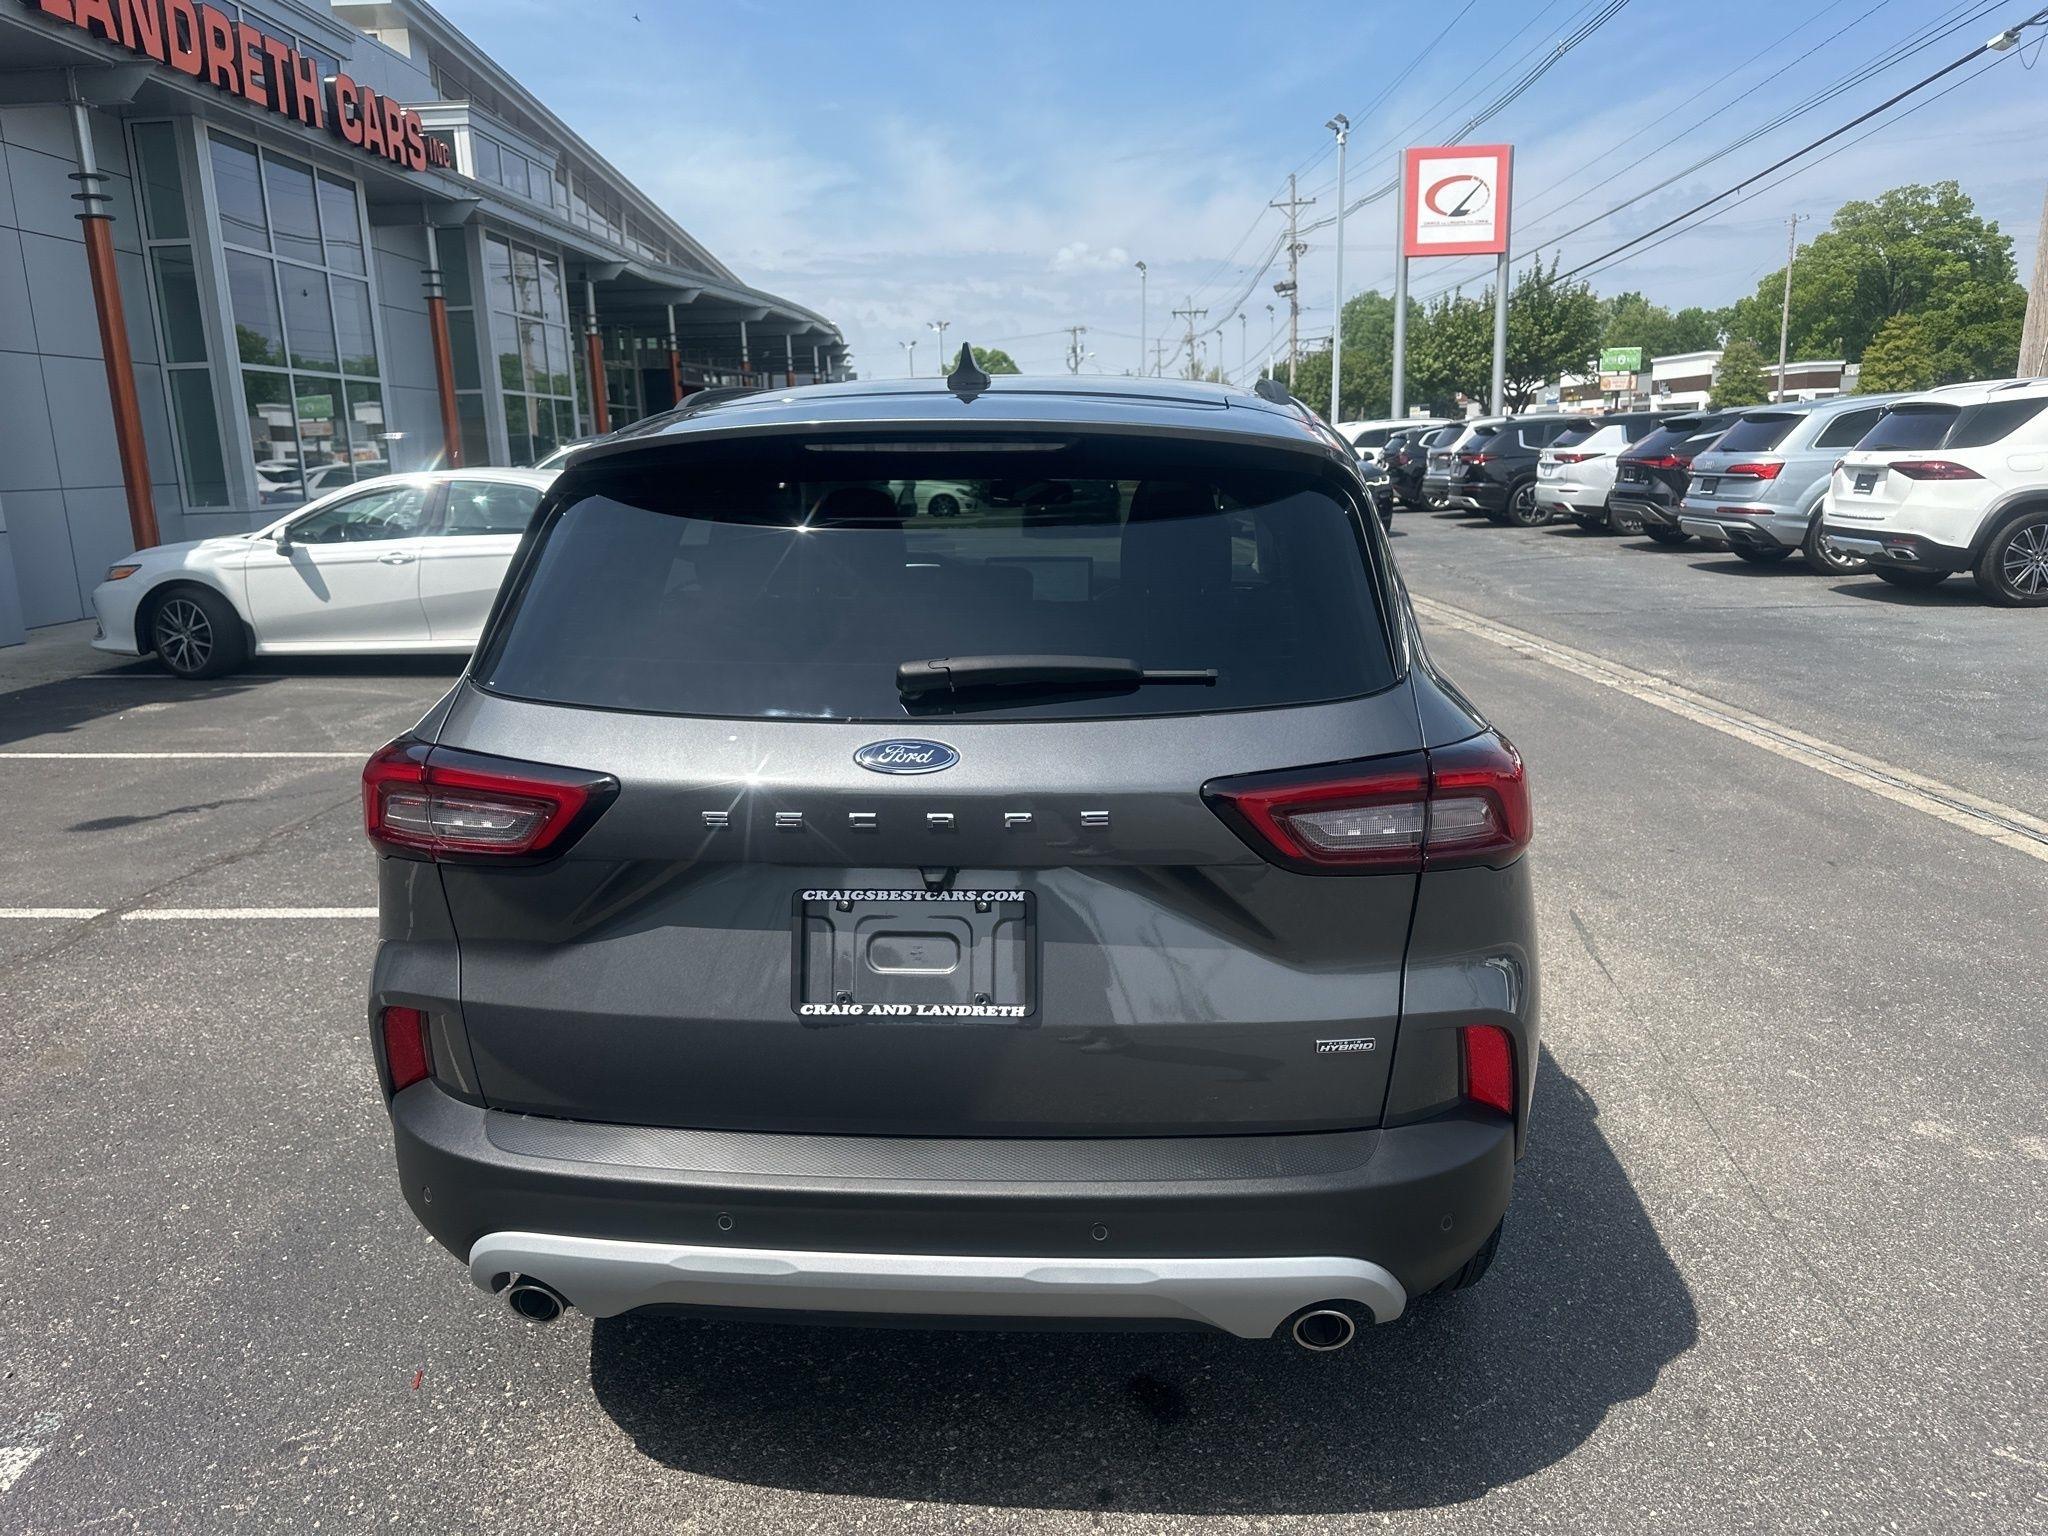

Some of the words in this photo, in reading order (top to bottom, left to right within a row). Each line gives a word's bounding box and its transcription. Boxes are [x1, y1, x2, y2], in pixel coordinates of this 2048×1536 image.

[40, 0, 324, 129] NDRETH
[335, 73, 427, 172] CARS
[429, 136, 451, 168] INC
[878, 744, 935, 764] Ford
[701, 810, 1110, 829] ESCAPE
[802, 890, 1025, 902] CRAIGSBESTCARS.COM
[800, 1004, 864, 1016] CRAIG
[868, 1004, 913, 1016] AND
[916, 1005, 1025, 1017] LANDRETH
[1319, 1042, 1374, 1052] HYBRID
